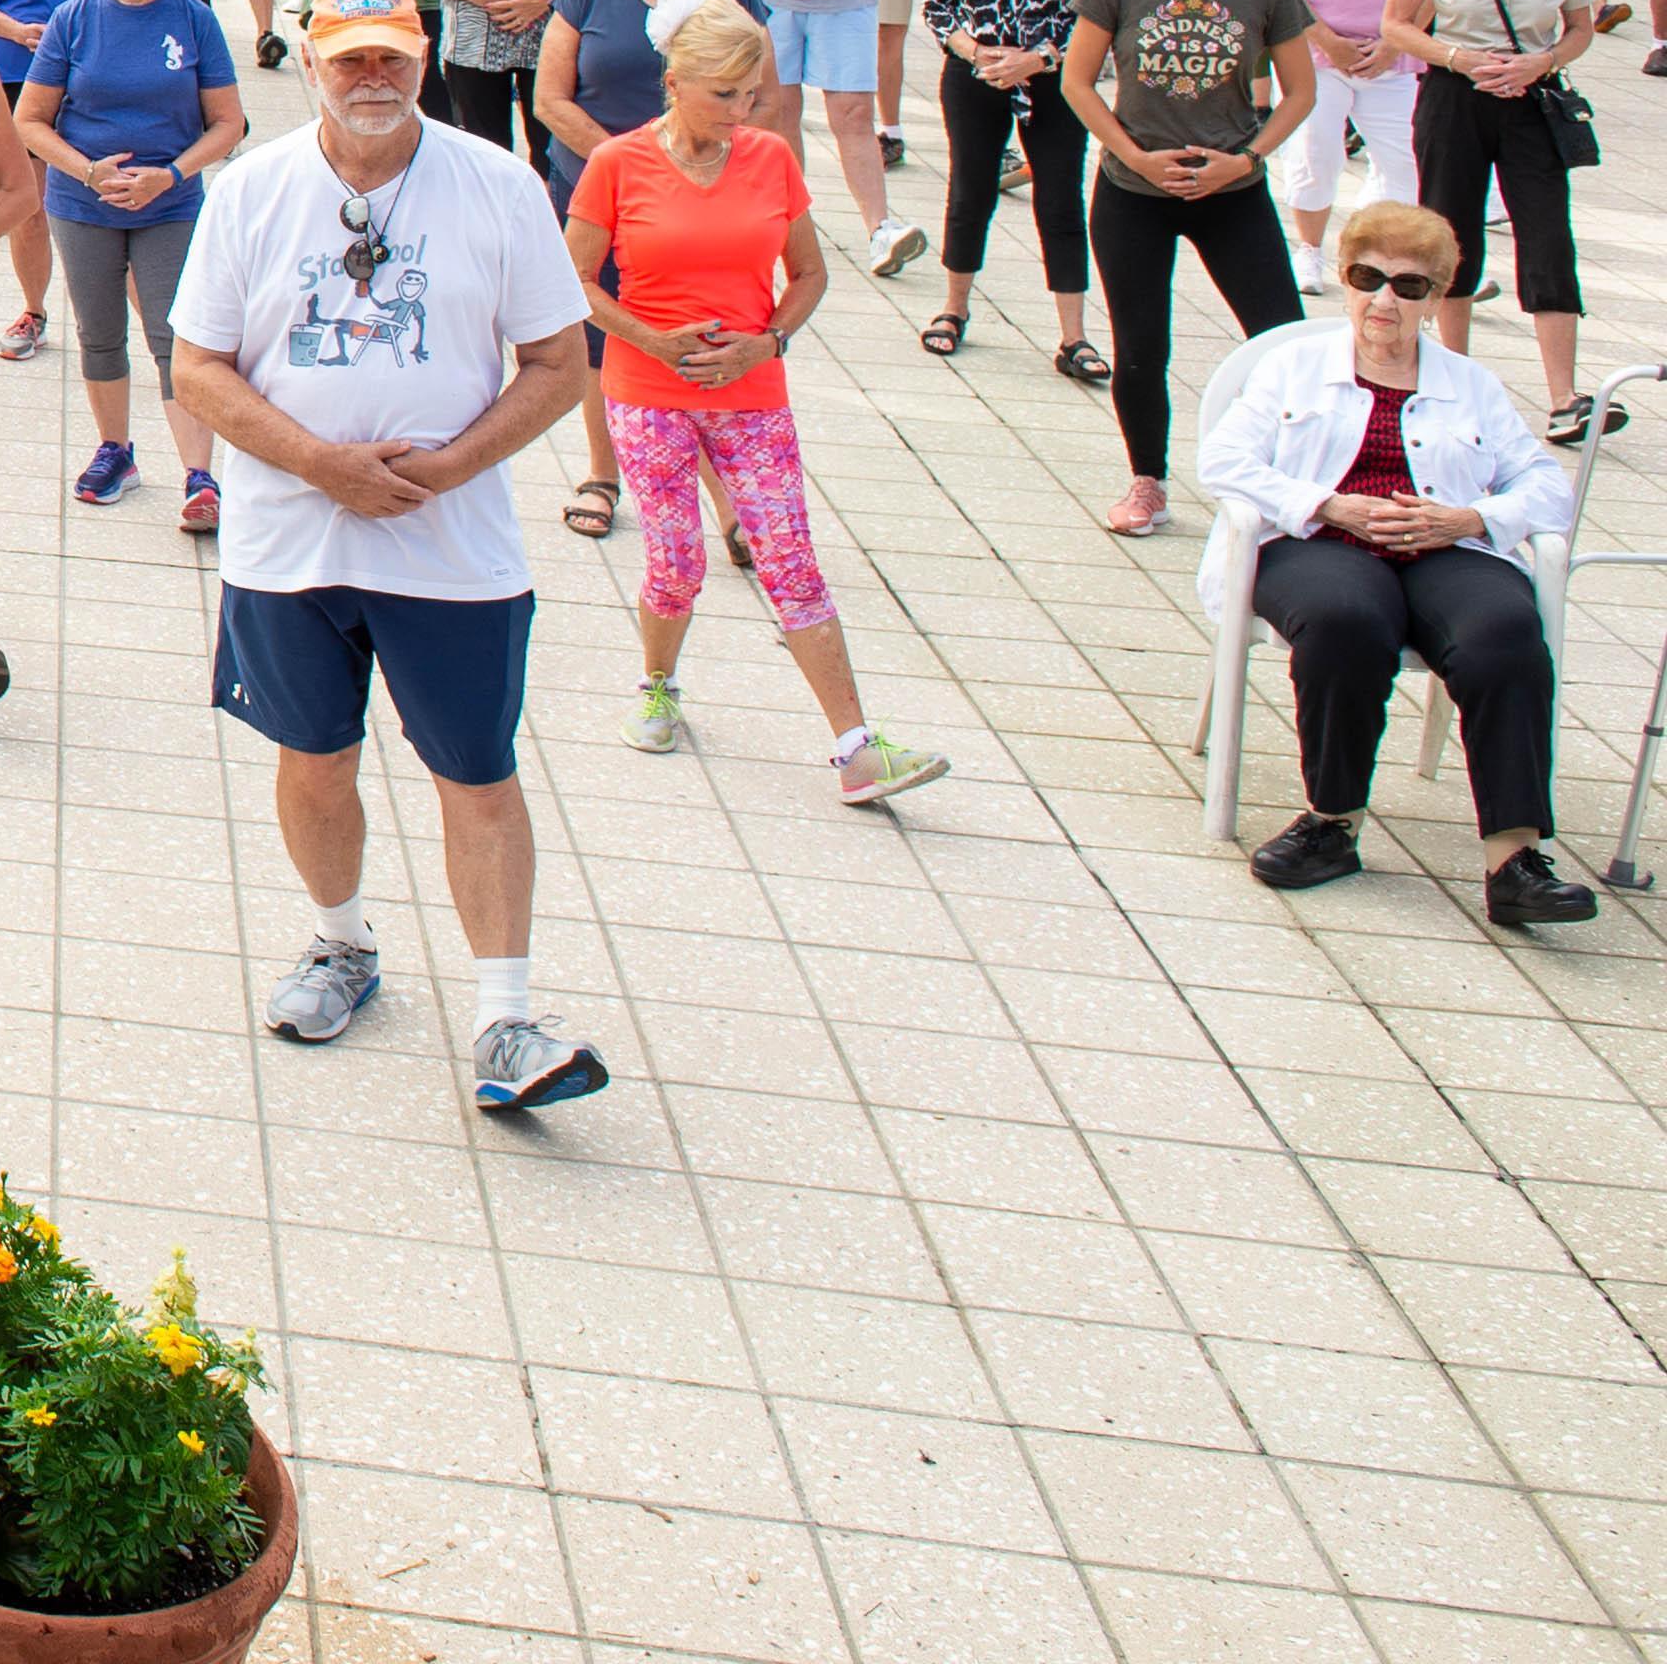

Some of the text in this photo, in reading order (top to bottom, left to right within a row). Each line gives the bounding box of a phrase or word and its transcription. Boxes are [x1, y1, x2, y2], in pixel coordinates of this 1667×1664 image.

[1138, 19, 1243, 55] KINDNESS
[1138, 53, 1239, 76] MAGIC
[298, 234, 427, 291] Sta ool
